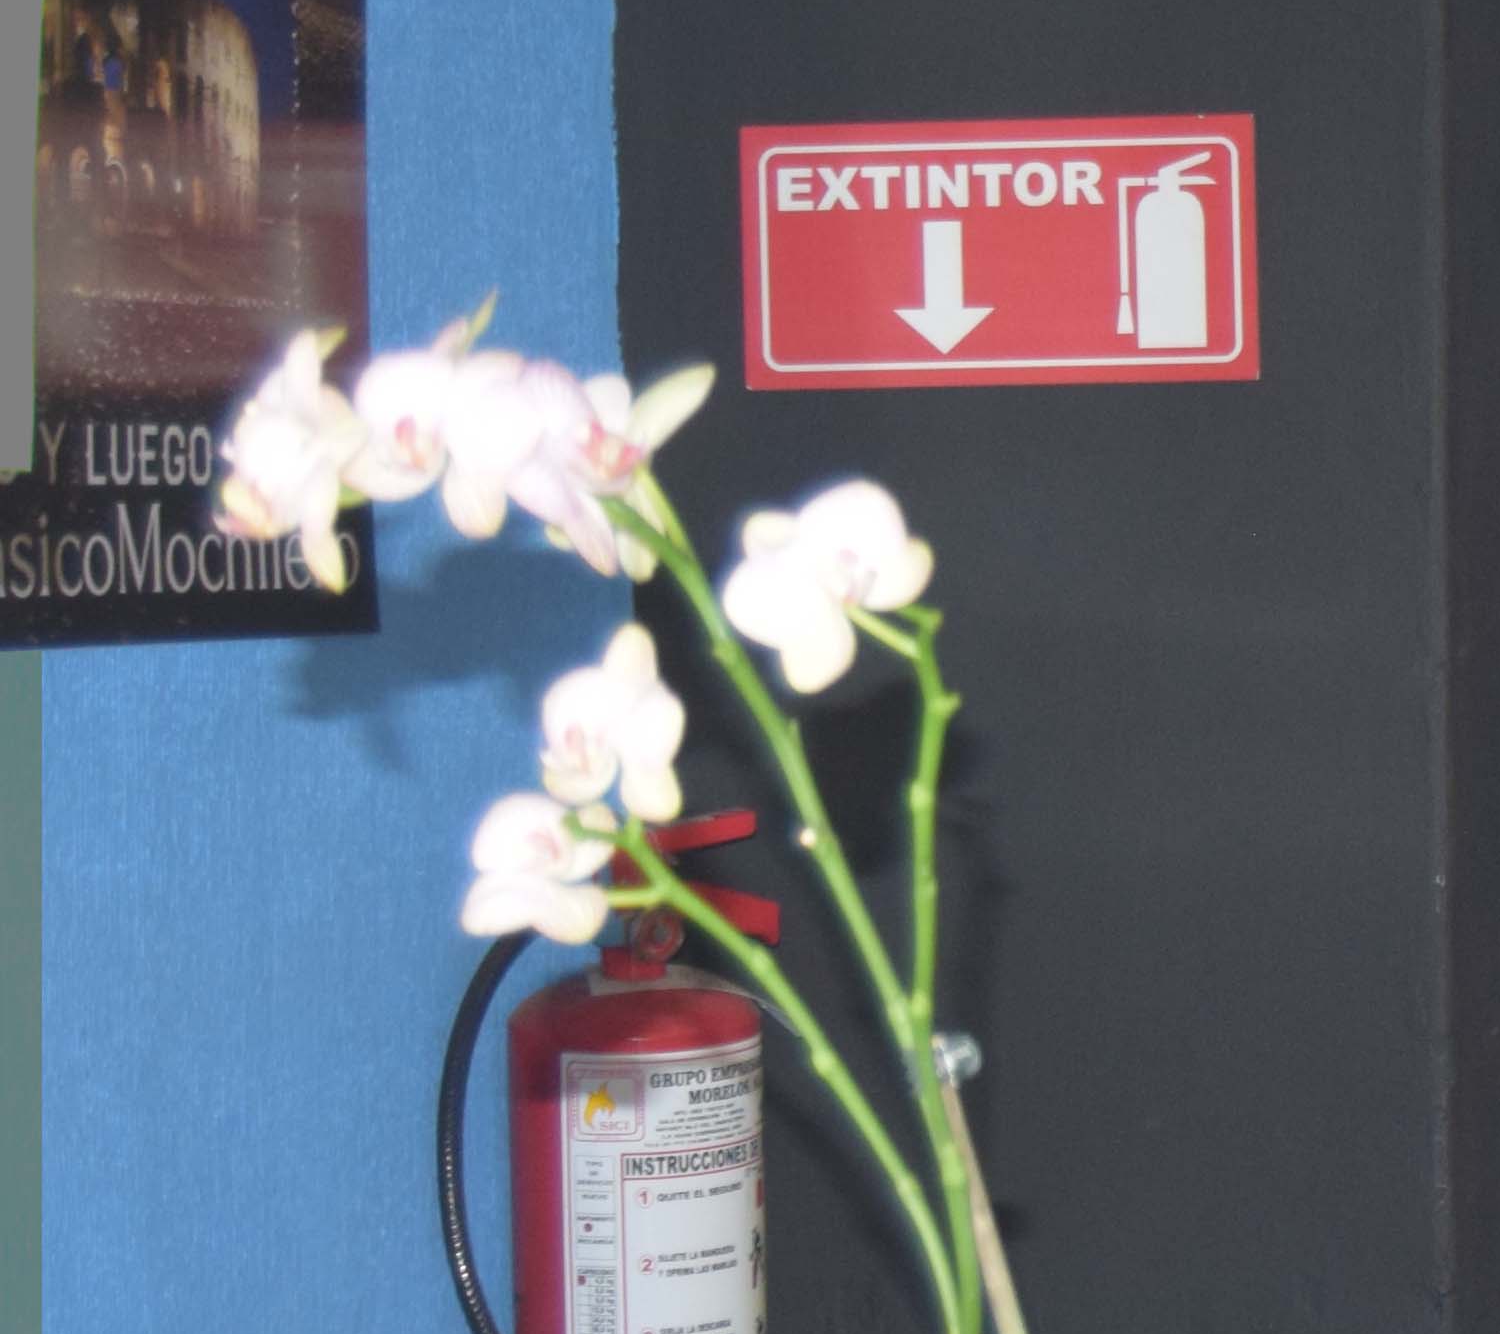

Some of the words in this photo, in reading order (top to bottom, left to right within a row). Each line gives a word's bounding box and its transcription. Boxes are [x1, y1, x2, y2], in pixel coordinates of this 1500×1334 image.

[776, 161, 1104, 212] EXTINTOR
[86, 422, 213, 486] LUEGO
[650, 1069, 706, 1089] GRUPO
[625, 1146, 748, 1176] INSTRUCCIONES
